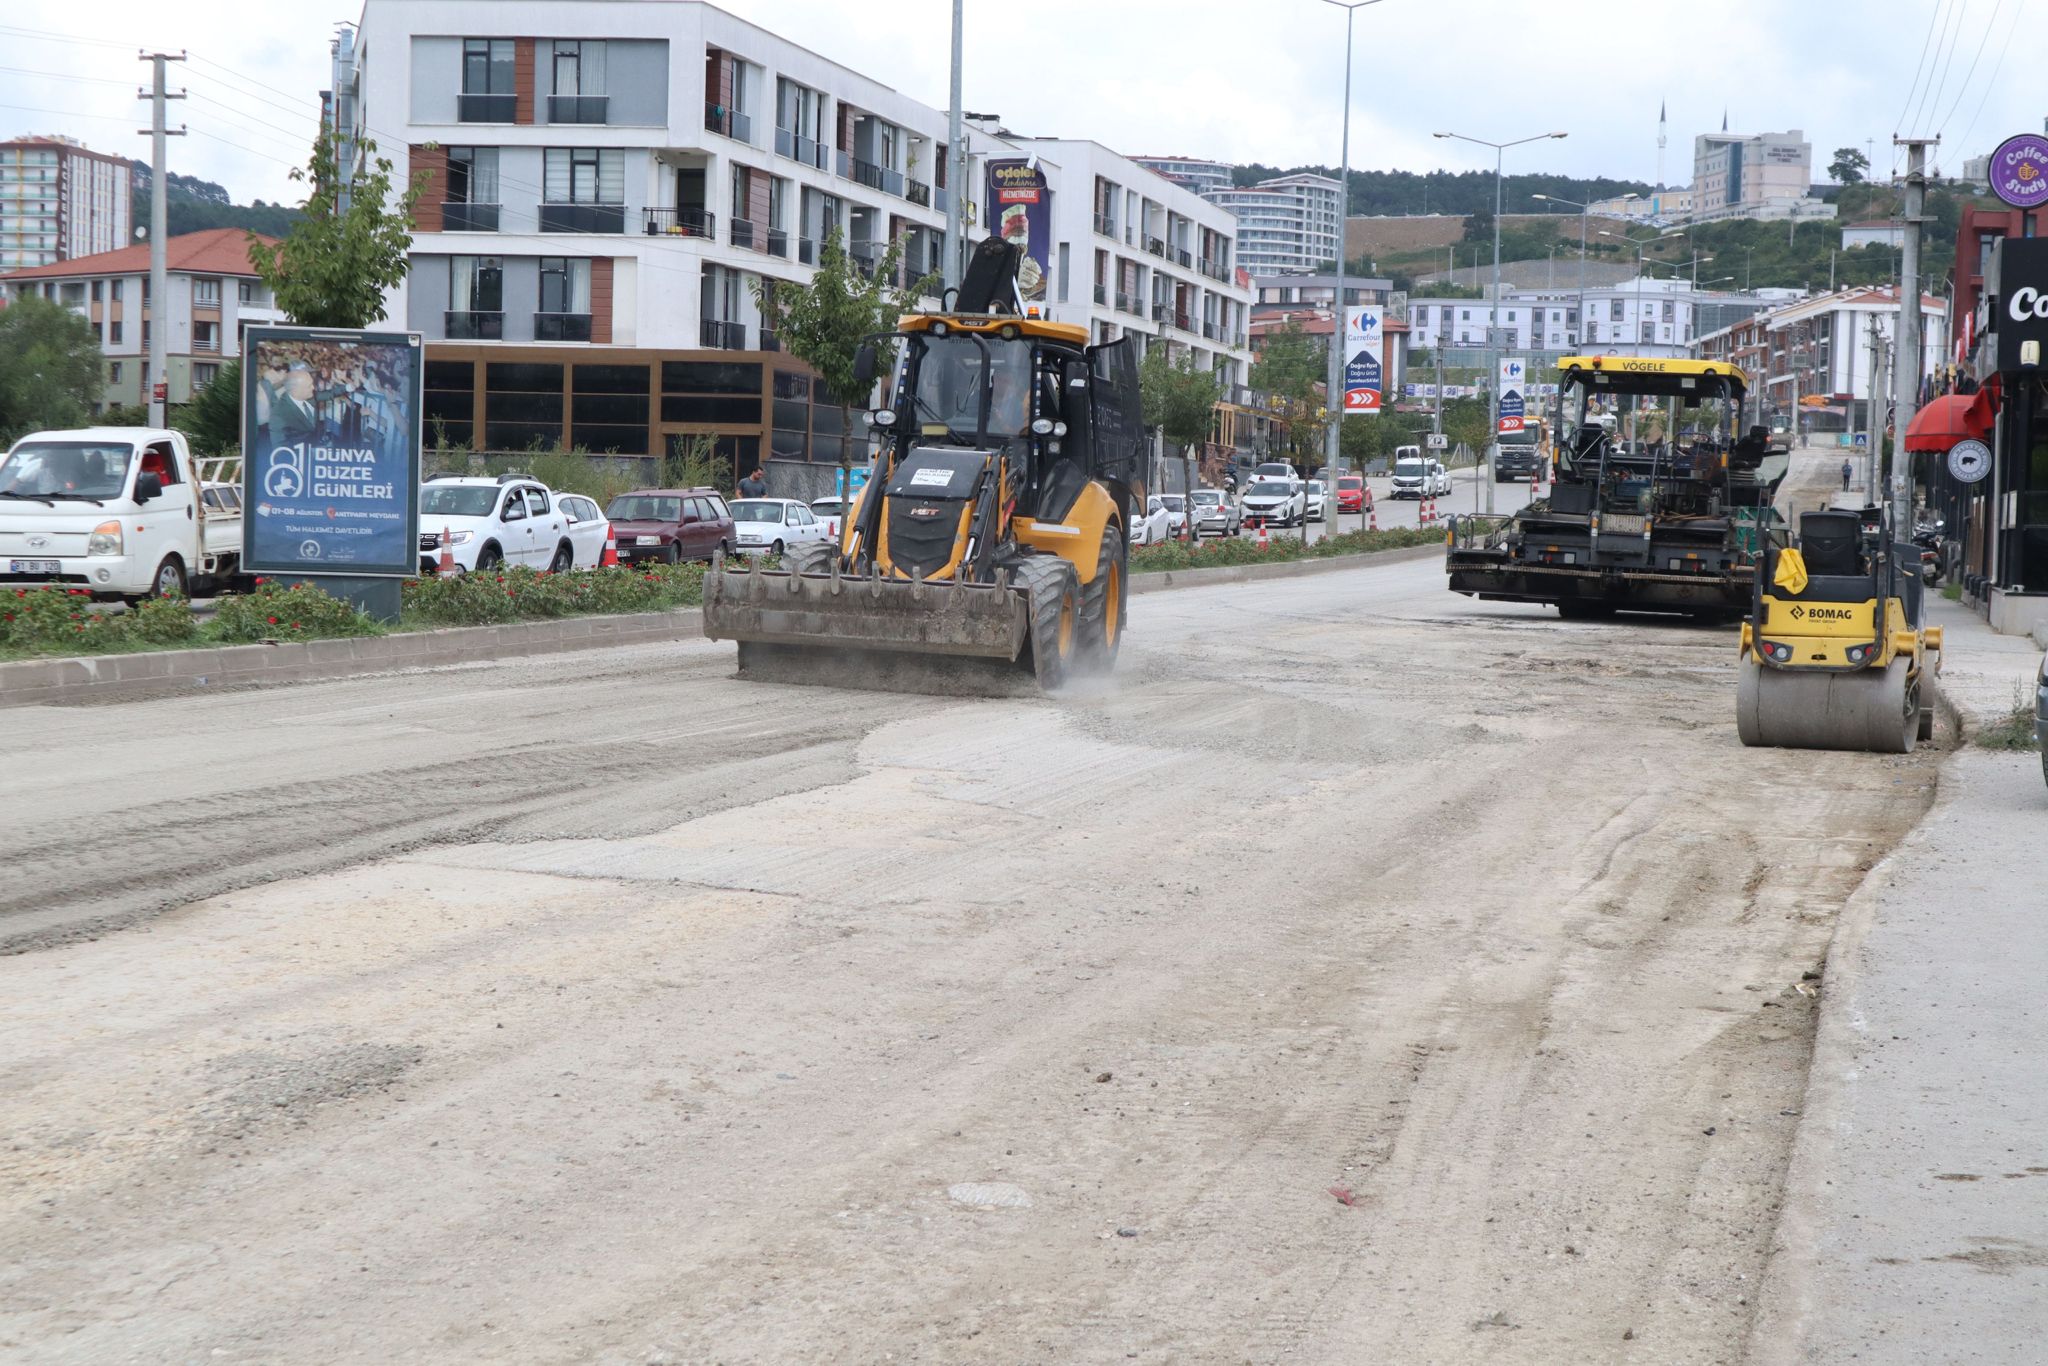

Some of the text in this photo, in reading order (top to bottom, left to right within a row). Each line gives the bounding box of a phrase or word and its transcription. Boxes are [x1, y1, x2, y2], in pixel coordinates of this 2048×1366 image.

[2006, 146, 2048, 166] Coffee
[2005, 178, 2047, 195] Study
[1347, 334, 1381, 342] Carrefour
[1350, 363, 1366, 371] Doğru
[1622, 360, 1666, 371] VÖGELE
[315, 447, 376, 464] DÜNYA
[314, 465, 373, 481] DÜZCE
[313, 482, 393, 499] GÜNLERİ
[271, 507, 295, 516] 01-08
[369, 512, 400, 520] MEYDANI
[910, 507, 940, 516] MST
[1808, 608, 1852, 620] BOMAG
